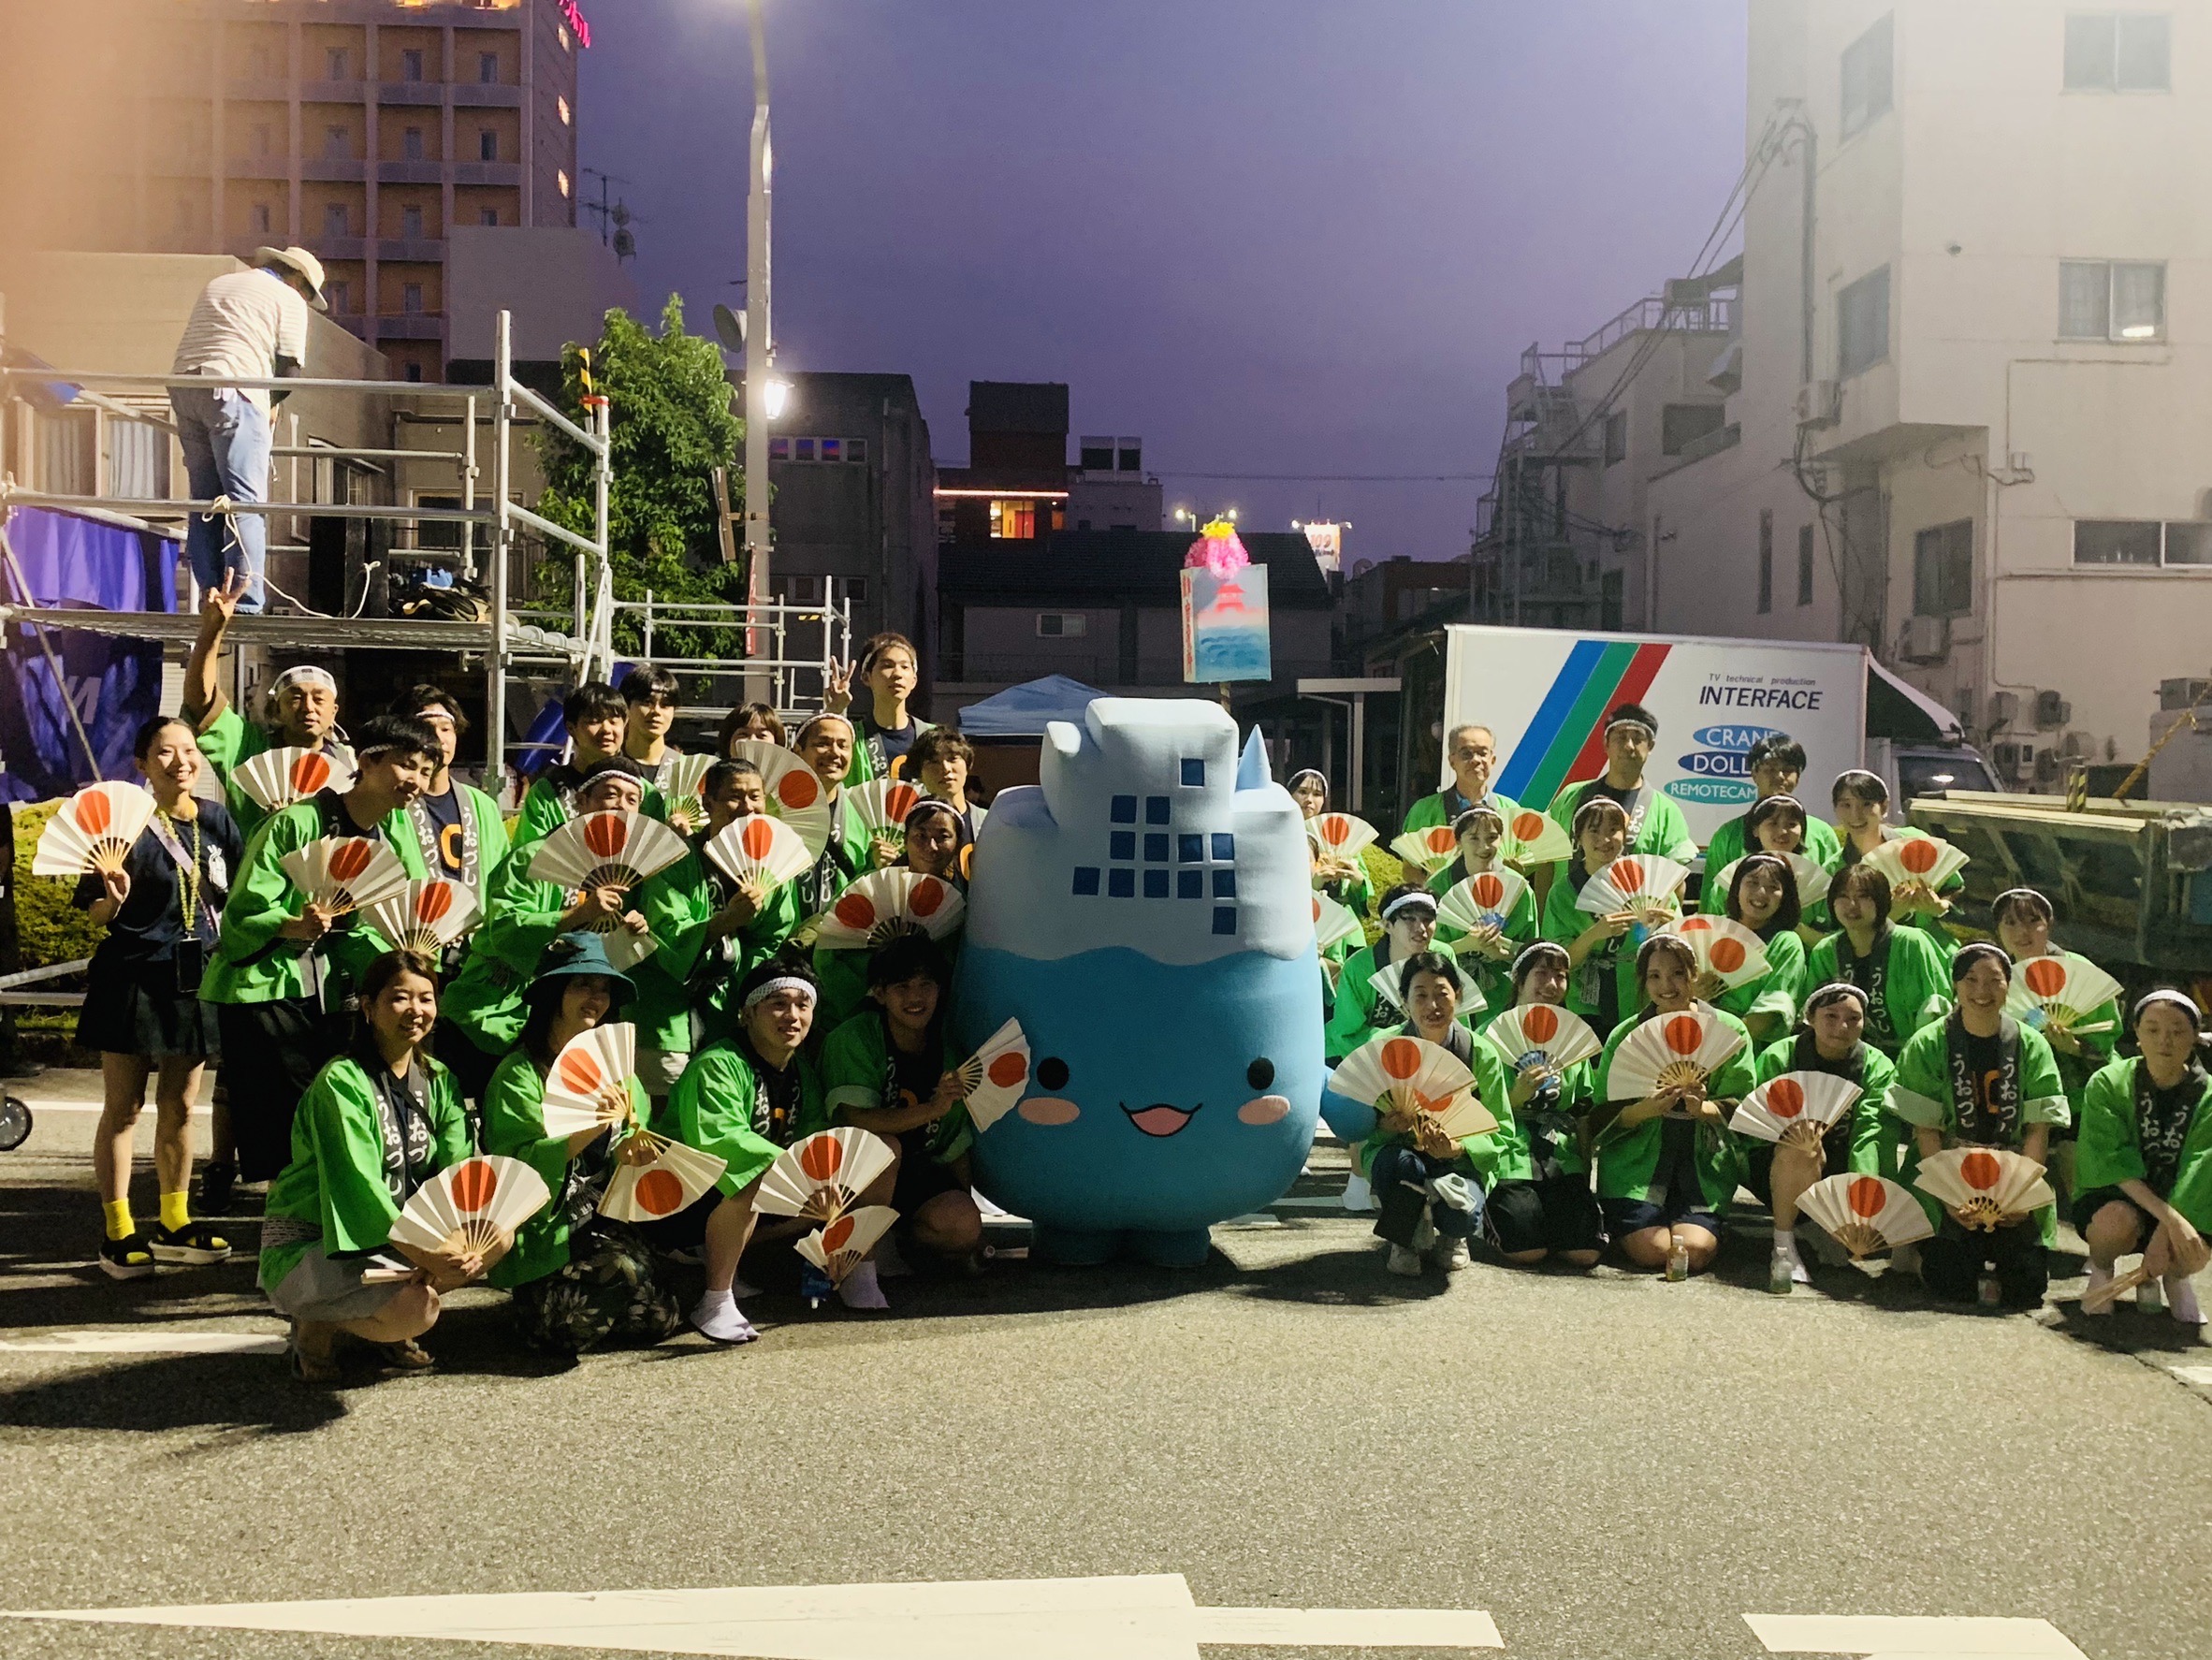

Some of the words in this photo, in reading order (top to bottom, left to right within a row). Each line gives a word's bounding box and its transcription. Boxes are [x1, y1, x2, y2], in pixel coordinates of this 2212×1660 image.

[1699, 686, 1823, 710] INTERFACE
[1709, 673, 1721, 681] TV
[1726, 675, 1763, 684] technical
[1770, 677, 1816, 686] production
[463, 806, 478, 887] うおづし
[376, 1095, 404, 1197] うおづし
